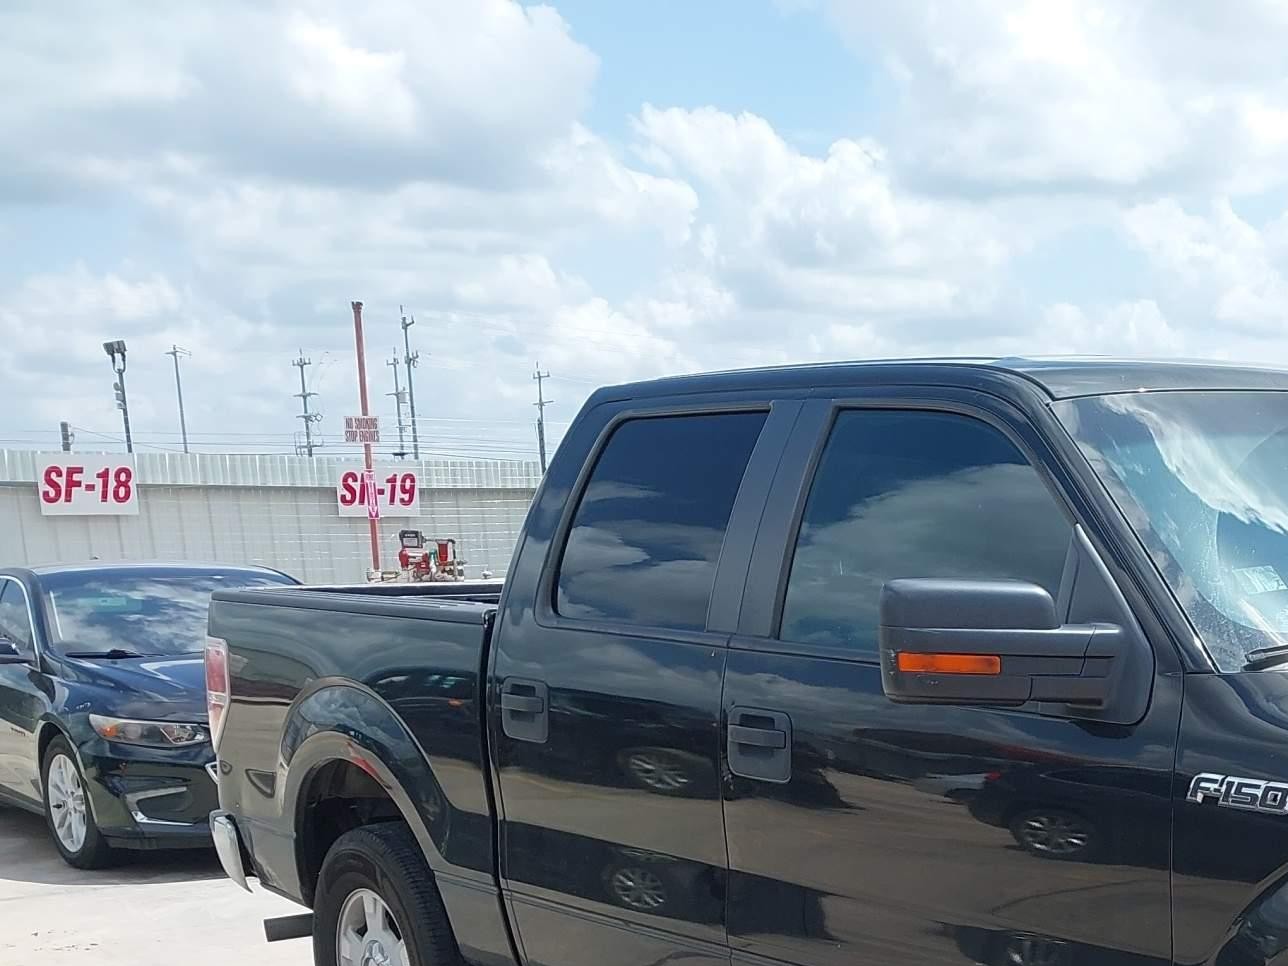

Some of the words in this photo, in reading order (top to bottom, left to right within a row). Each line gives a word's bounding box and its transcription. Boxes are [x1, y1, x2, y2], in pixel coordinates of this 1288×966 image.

[345, 417, 353, 429] NO
[354, 417, 378, 429] SMOKING
[345, 430, 358, 442] STOP
[359, 430, 380, 442] ENGINES
[42, 465, 132, 503] SF-18
